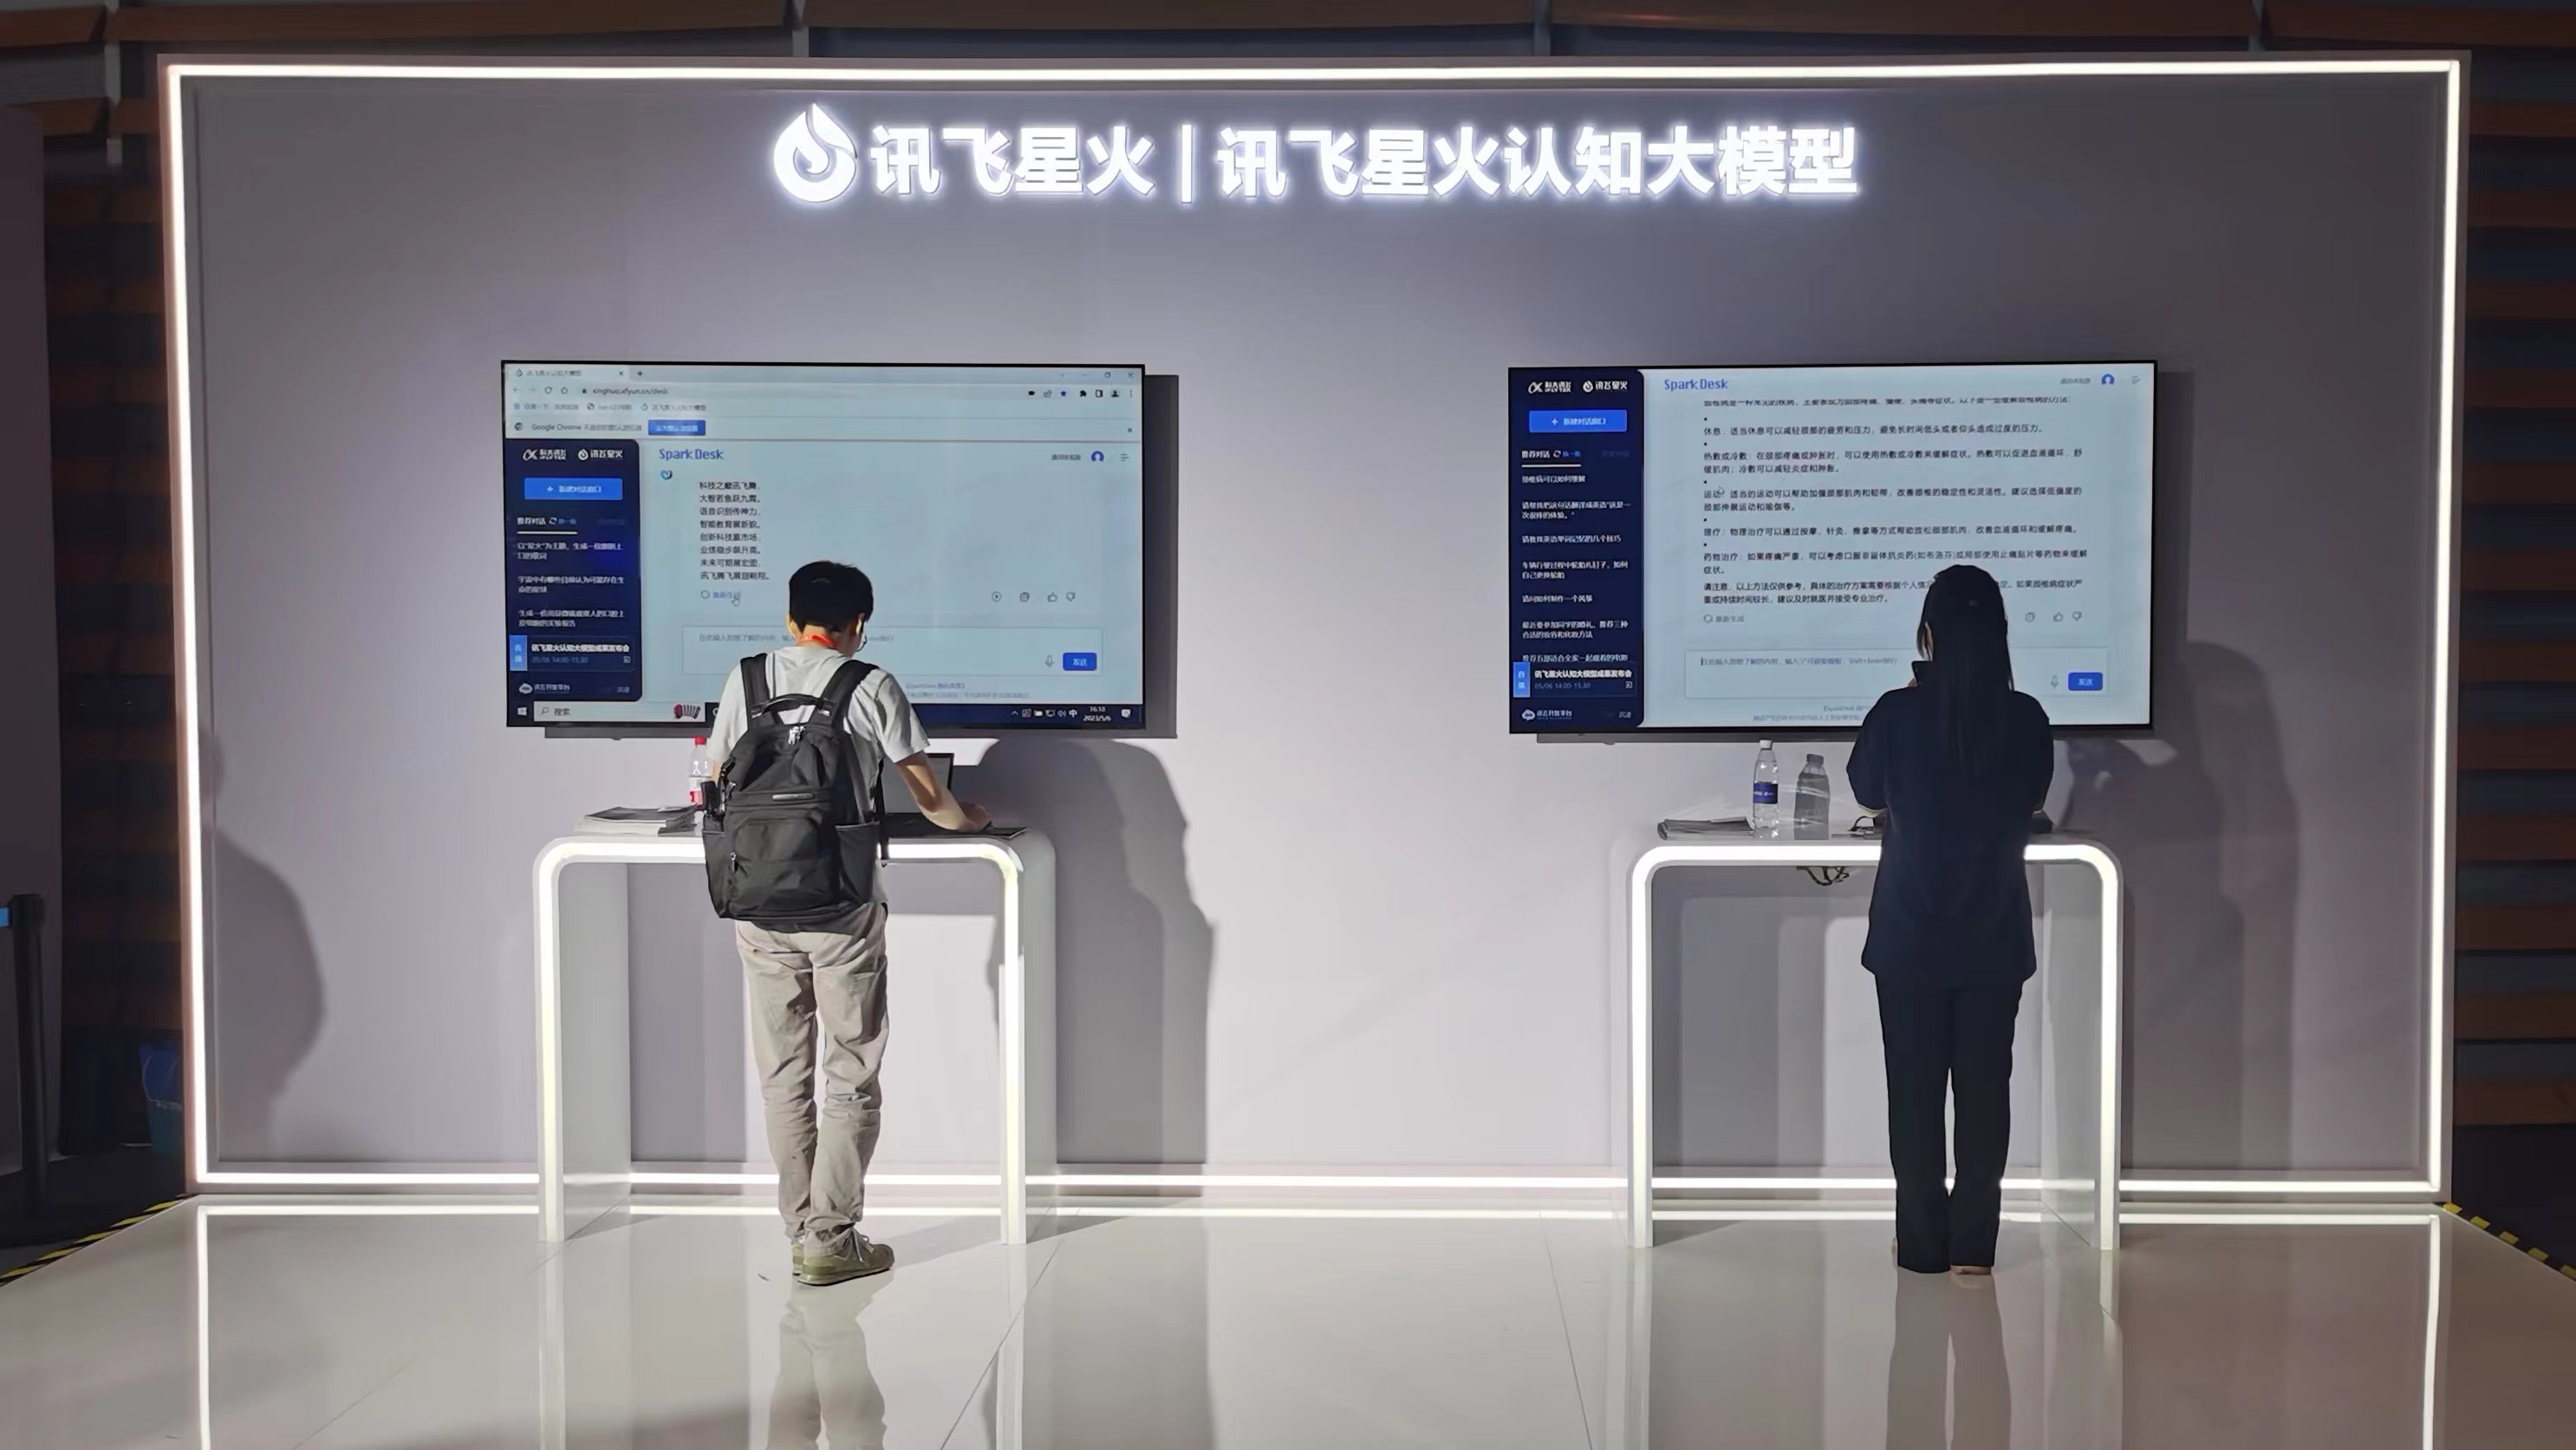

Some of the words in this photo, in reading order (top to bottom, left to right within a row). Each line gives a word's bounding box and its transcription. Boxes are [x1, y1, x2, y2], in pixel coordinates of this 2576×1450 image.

[868, 124, 1151, 198] 讯飞星火
[1217, 123, 1859, 199] 讯飞星火认知大模型
